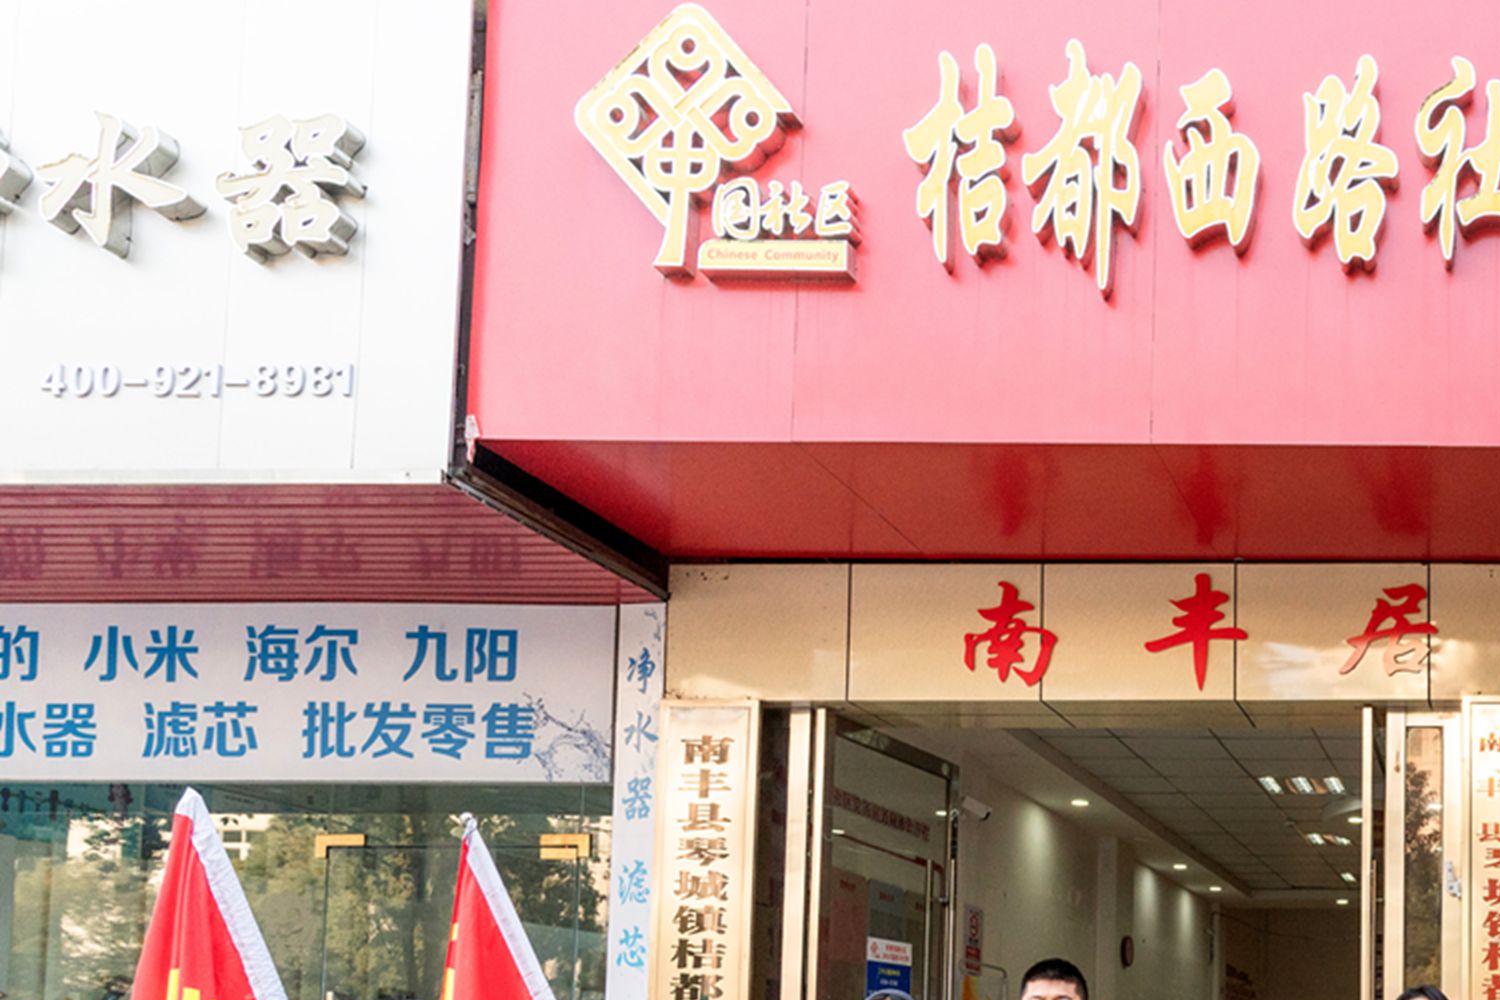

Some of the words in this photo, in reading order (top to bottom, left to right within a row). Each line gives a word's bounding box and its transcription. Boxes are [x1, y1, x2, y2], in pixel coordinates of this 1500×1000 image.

[0, 110, 368, 268] 水器
[706, 248, 759, 261] Chinese
[763, 249, 840, 264] Community
[39, 362, 356, 399] 400-921-8981
[83, 625, 199, 682] 小米
[243, 624, 359, 682] 海尔
[402, 624, 519, 683] 九阳
[142, 701, 258, 758] 滤芯
[301, 701, 535, 760] 批发零售
